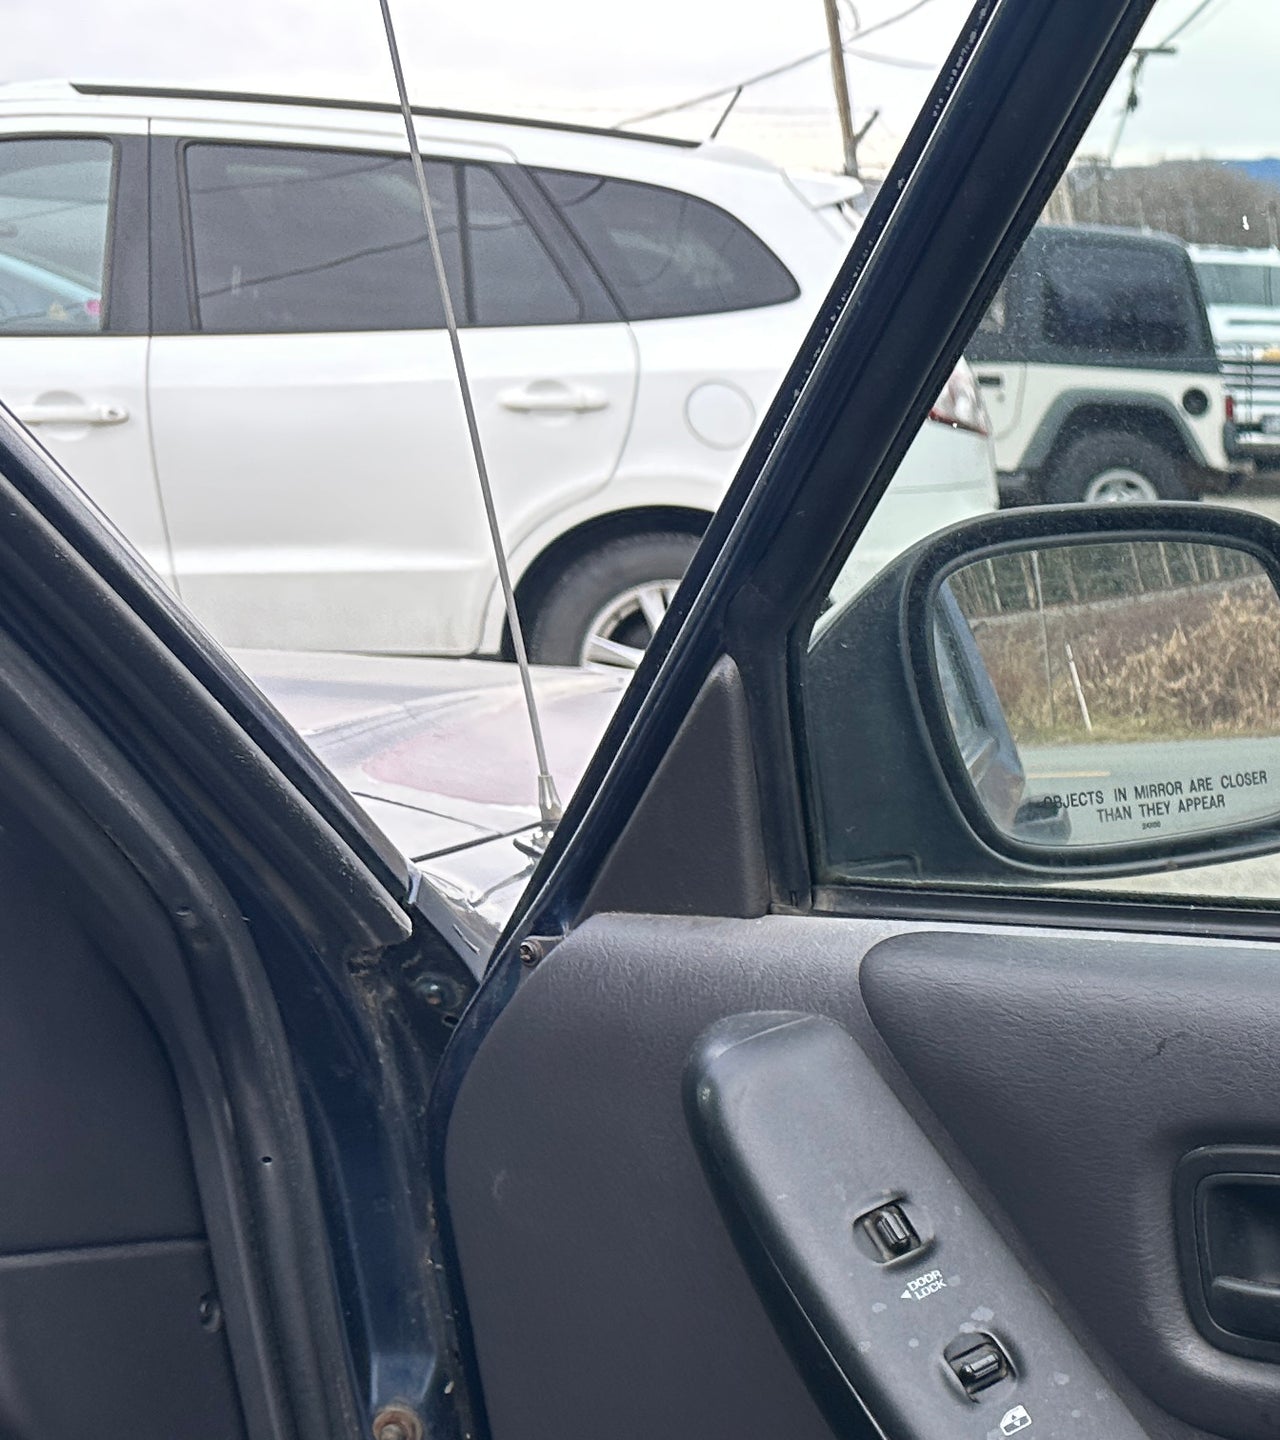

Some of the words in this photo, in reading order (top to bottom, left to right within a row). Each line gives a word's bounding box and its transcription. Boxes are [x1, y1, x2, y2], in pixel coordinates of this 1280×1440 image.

[1044, 790, 1105, 809] OBJECTS
[1114, 787, 1128, 802] IN
[1134, 781, 1184, 799] MIRROR
[1190, 777, 1214, 793] ARE
[1221, 770, 1269, 789] CLOSER
[1097, 806, 1133, 823] THAN
[1139, 800, 1171, 817] THEY
[1178, 794, 1226, 813] APPEAR
[907, 1270, 943, 1291] DOOR
[913, 1279, 947, 1300] LOCK
